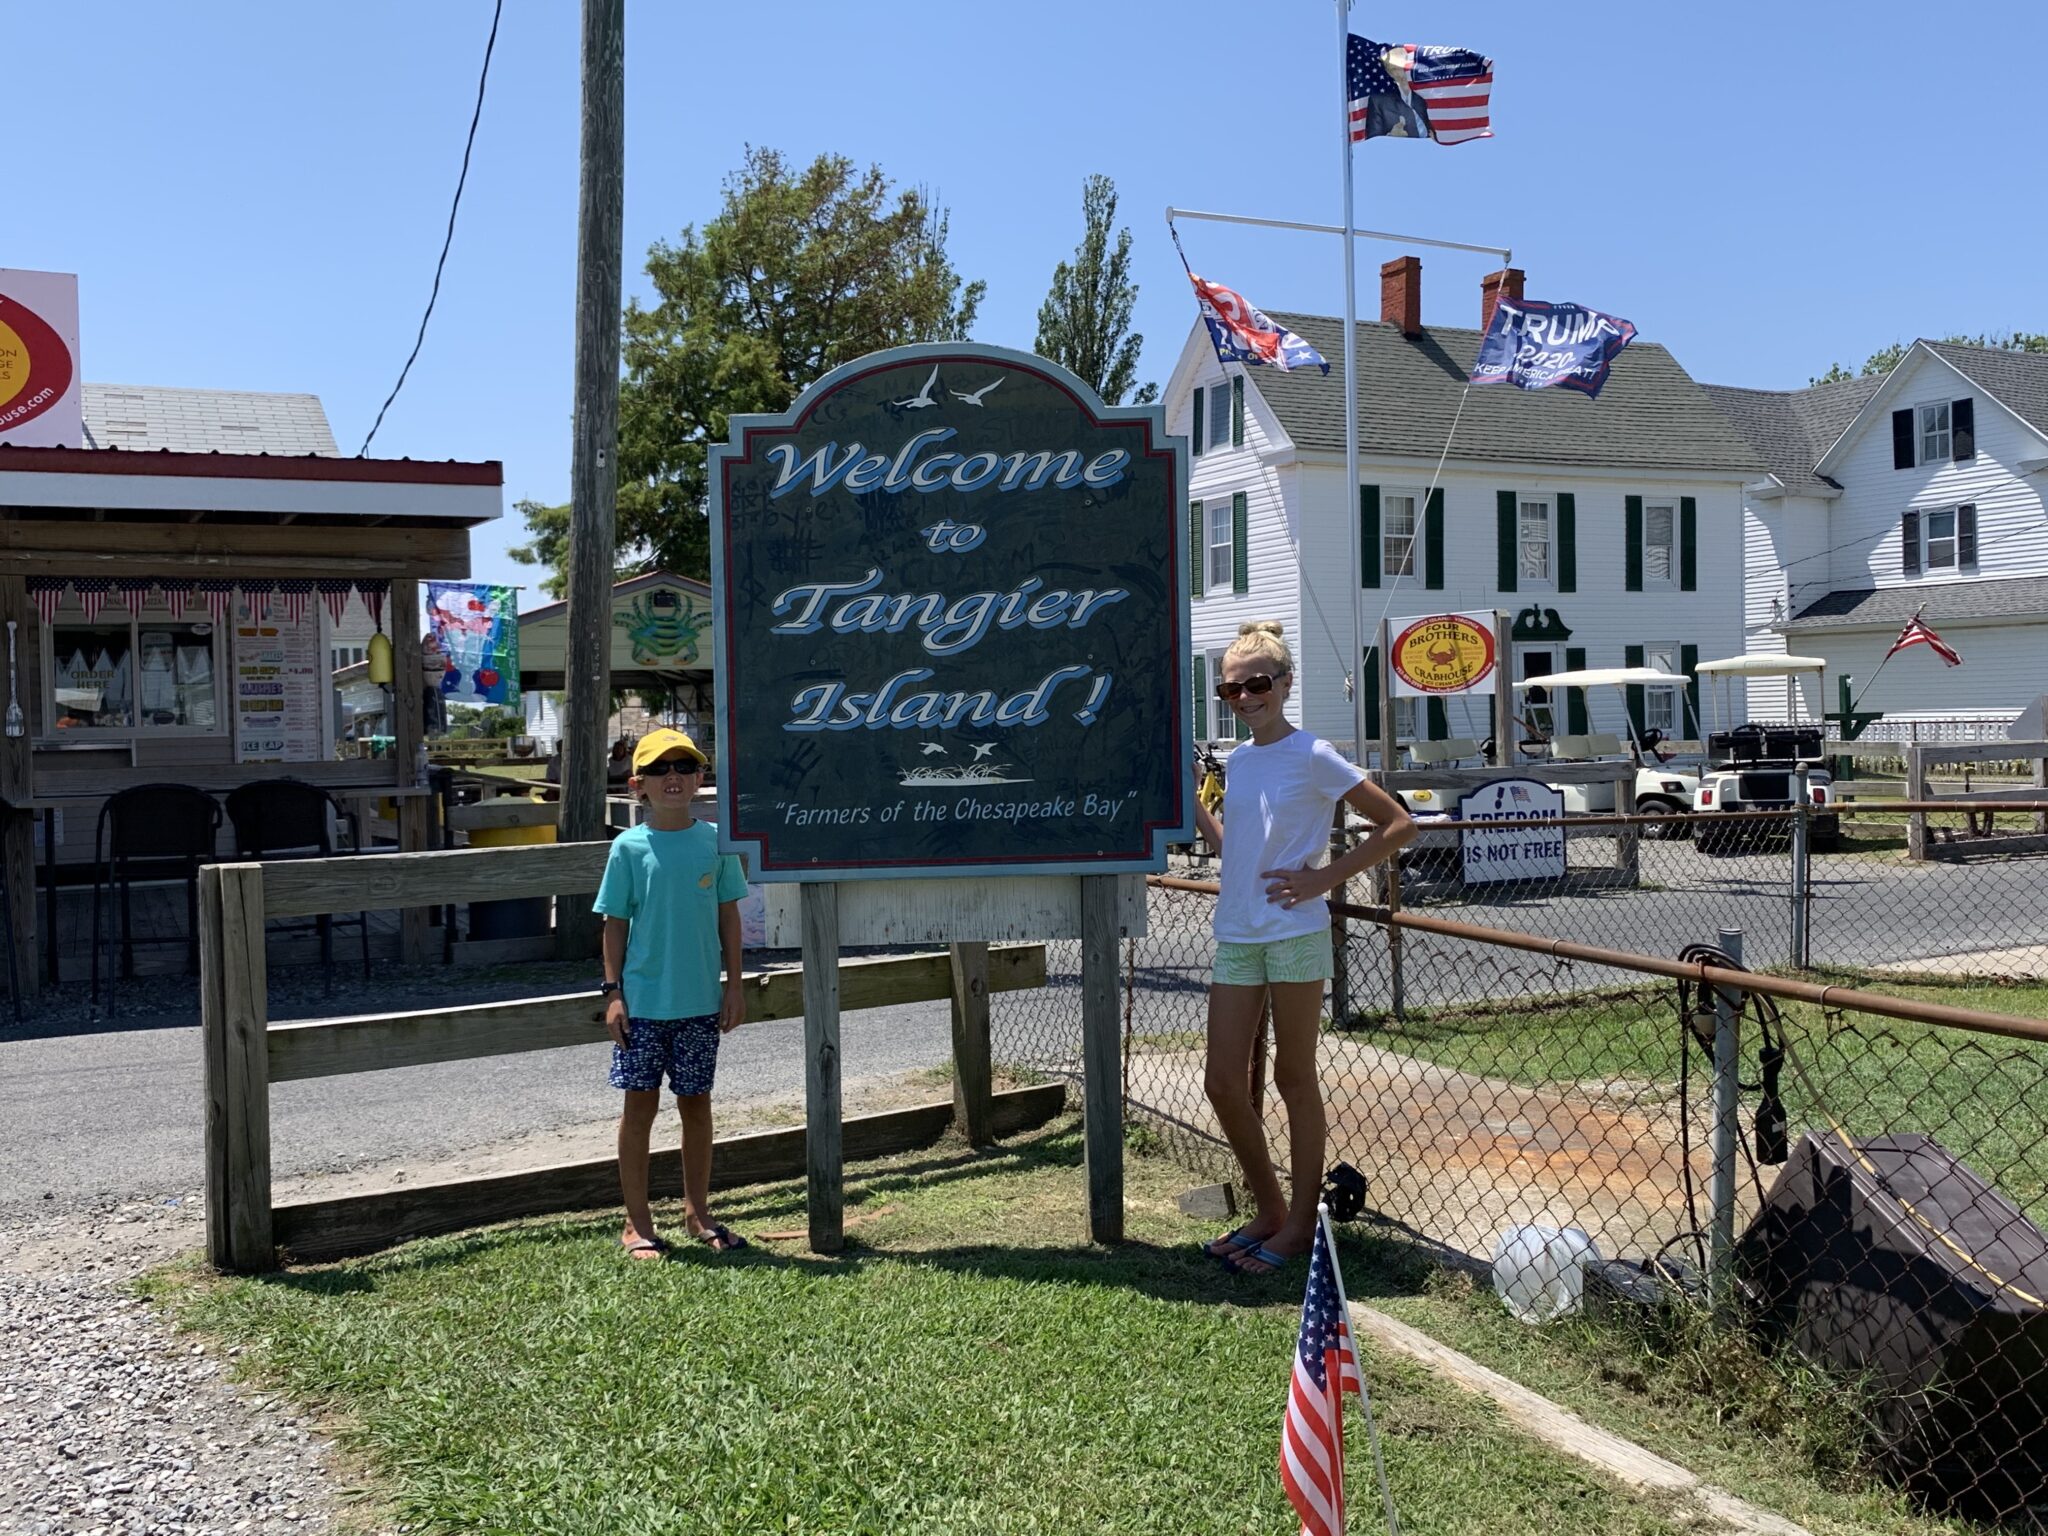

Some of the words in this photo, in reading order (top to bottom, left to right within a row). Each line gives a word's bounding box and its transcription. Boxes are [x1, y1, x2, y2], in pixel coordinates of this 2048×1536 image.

[1500, 304, 1620, 346] TRUMP
[1474, 363, 1506, 375] KEEP
[767, 427, 1131, 497] Welcome
[921, 519, 987, 553] to
[770, 567, 1130, 656] Tangier
[1409, 631, 1479, 648] BROTHERS
[1425, 623, 1459, 634] FOUR
[71, 671, 115, 679] ORDER
[1414, 661, 1473, 681] CRABHOUSE
[76, 680, 111, 689] HERE
[775, 801, 871, 826] "Farmers
[880, 800, 905, 823] of
[913, 799, 946, 822] the
[955, 795, 1075, 825] Chesapeake
[1083, 790, 1138, 823] Bay"
[1470, 809, 1556, 835] FREEDOM
[1466, 845, 1482, 864] IS
[1487, 843, 1518, 862] NOT
[1524, 841, 1562, 860] FREE
